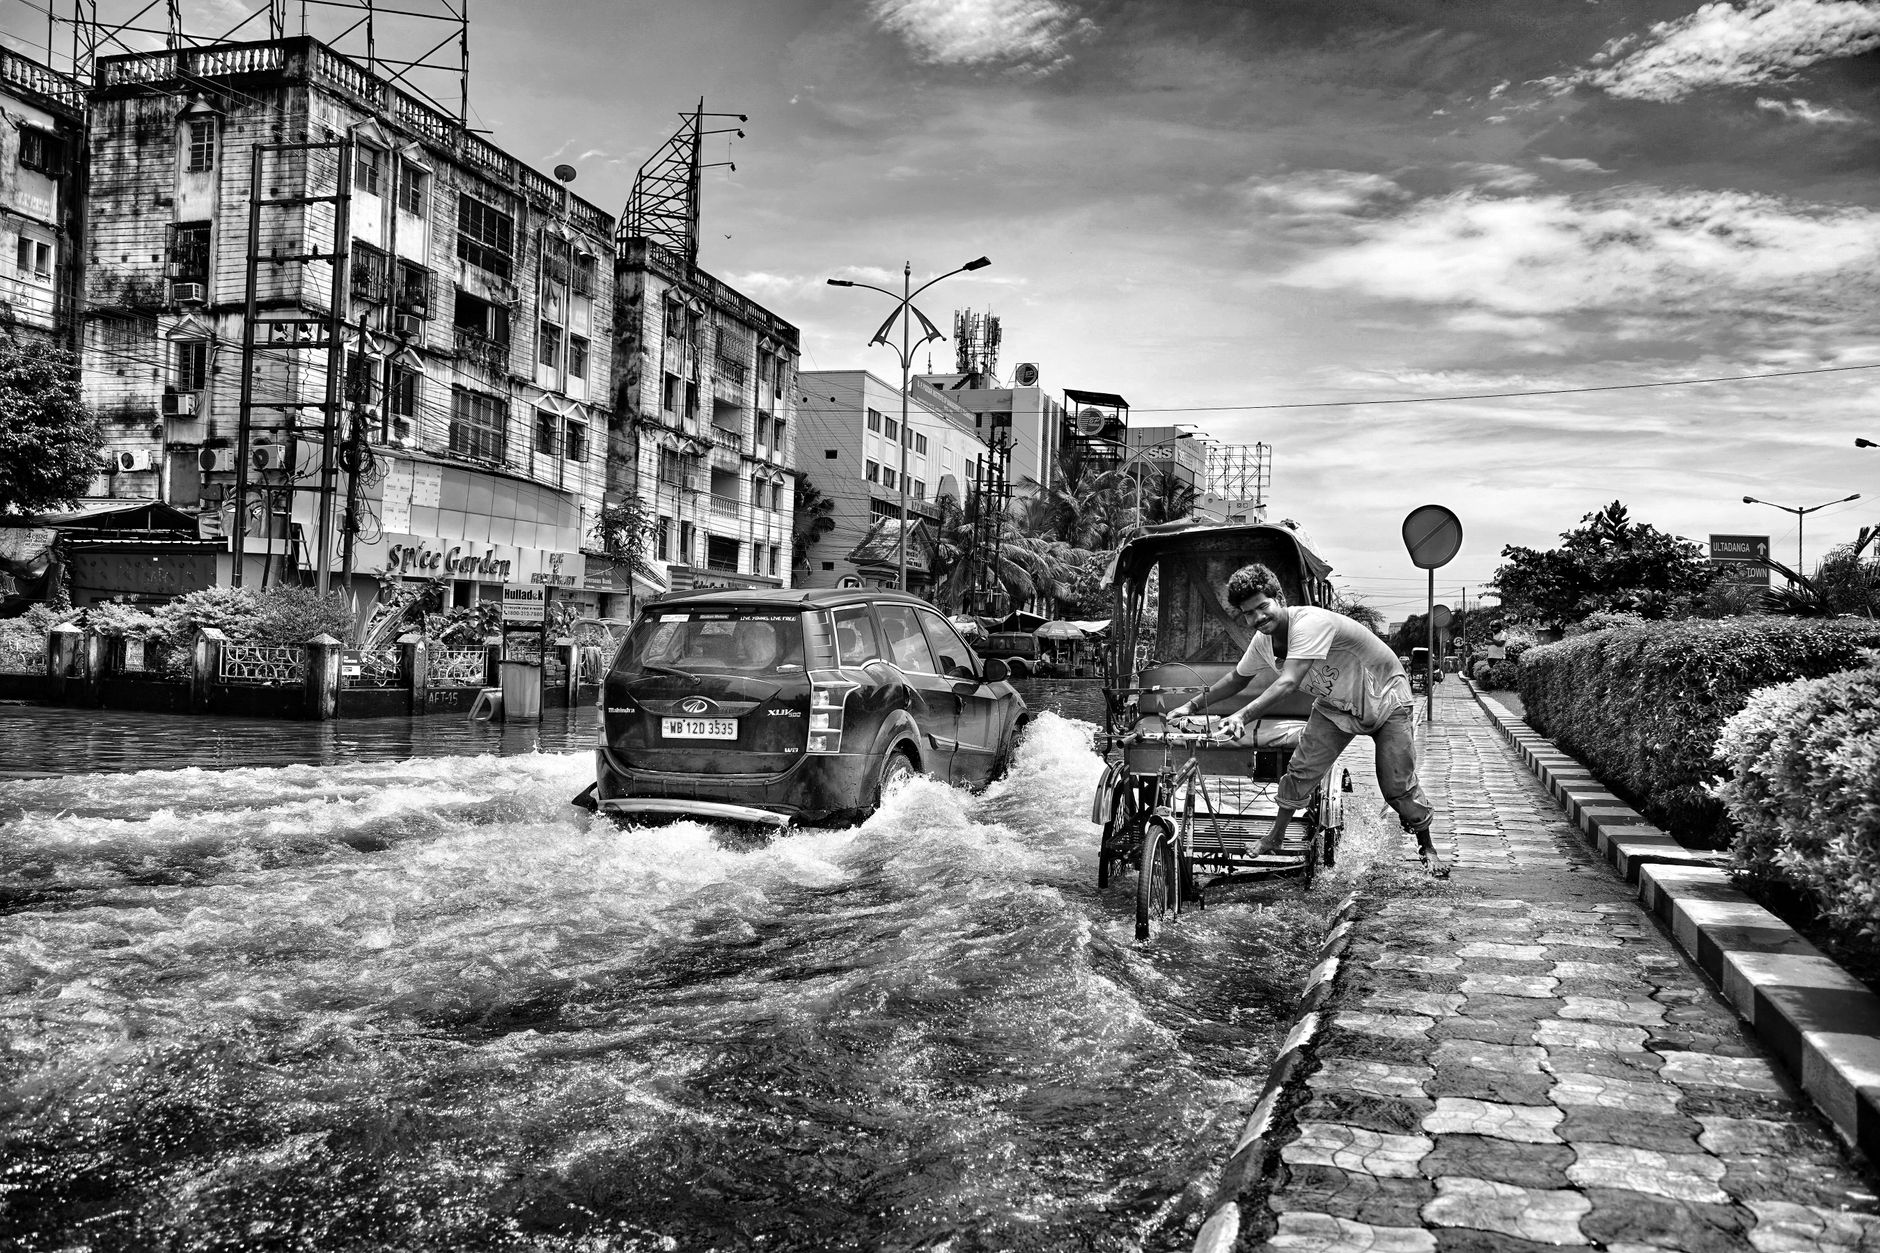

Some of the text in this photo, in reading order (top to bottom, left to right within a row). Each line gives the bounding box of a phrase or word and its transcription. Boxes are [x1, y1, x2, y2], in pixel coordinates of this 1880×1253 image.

[1713, 542, 1750, 552] ULTADANGA
[387, 541, 511, 577] Spice Garden
[1746, 567, 1767, 578] TOWN
[504, 588, 543, 600] Hulladek
[670, 721, 683, 734] WB
[686, 721, 705, 735] 12D
[708, 722, 734, 736] 3535
